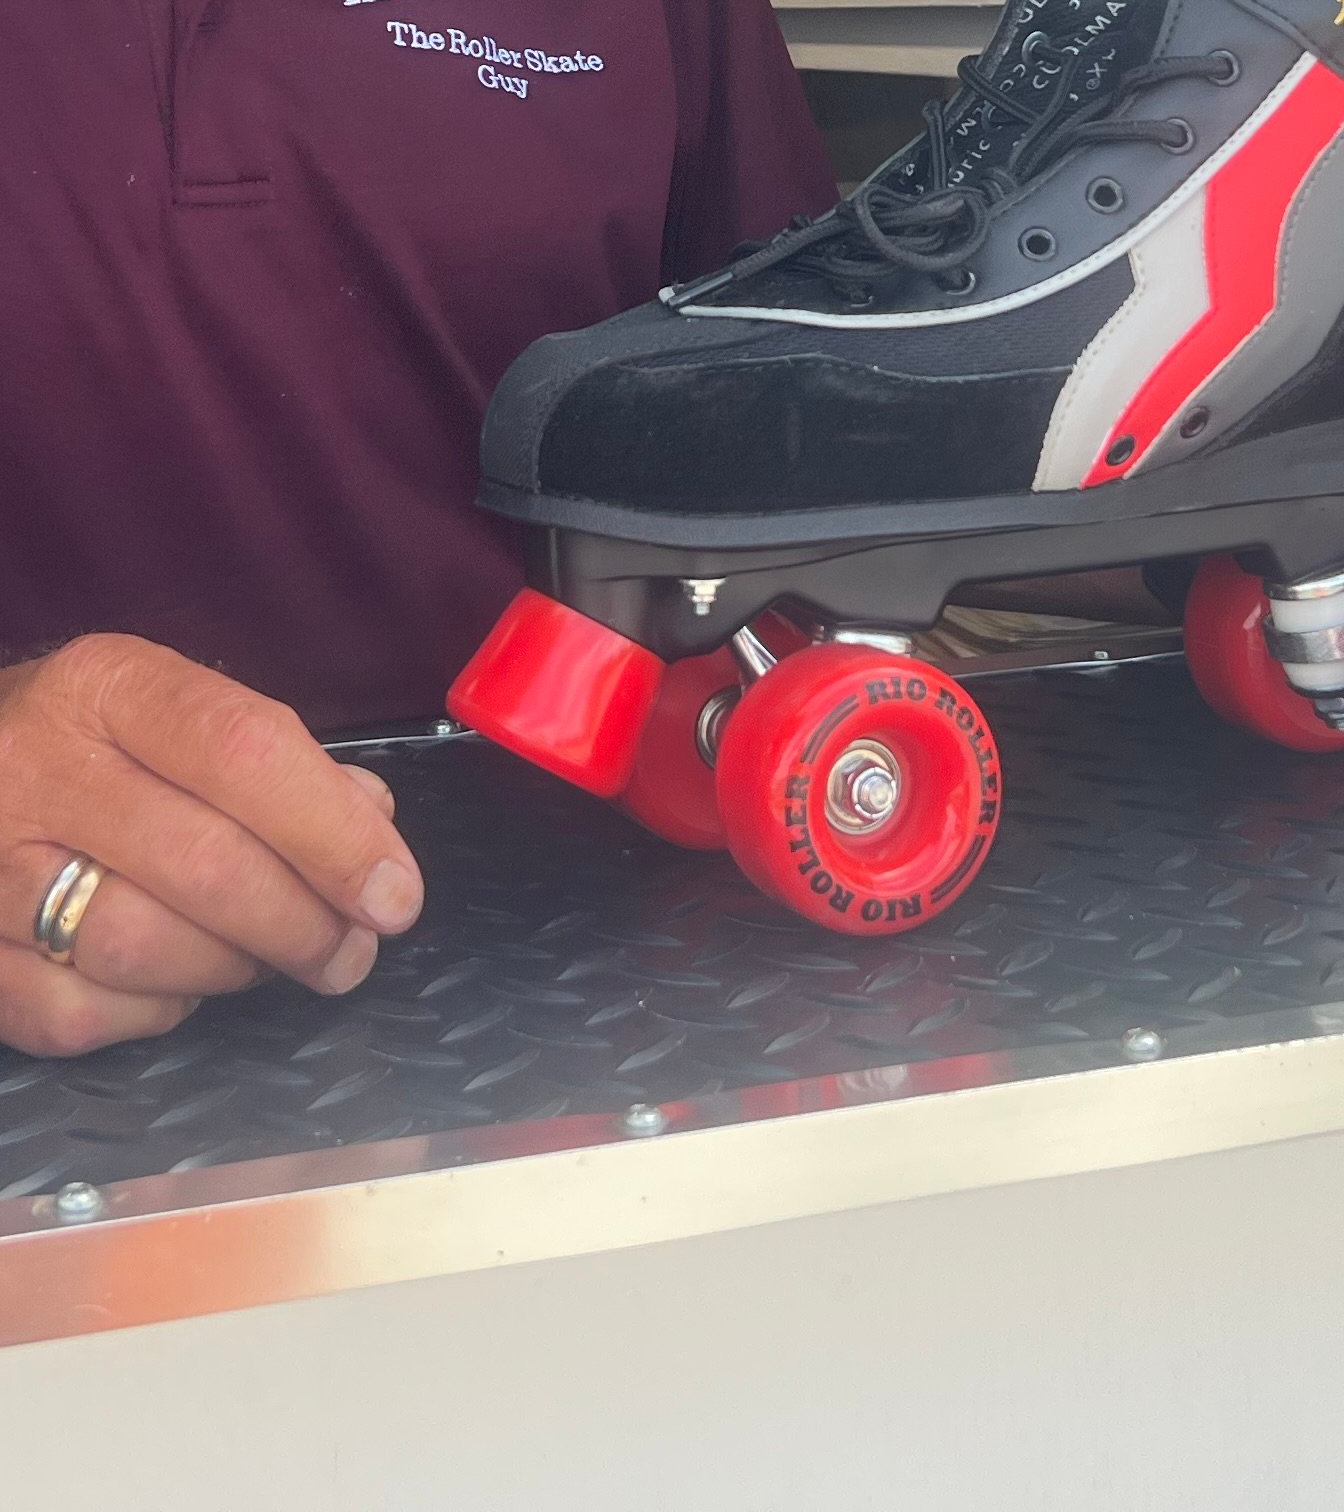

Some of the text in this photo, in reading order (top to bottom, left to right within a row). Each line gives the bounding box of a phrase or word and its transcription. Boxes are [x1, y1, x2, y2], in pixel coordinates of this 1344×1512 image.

[386, 20, 605, 74] The Roller Skate
[477, 64, 529, 99] Guy
[864, 676, 999, 826] RIO ROLLER
[784, 773, 923, 922] RIO ROLLER
